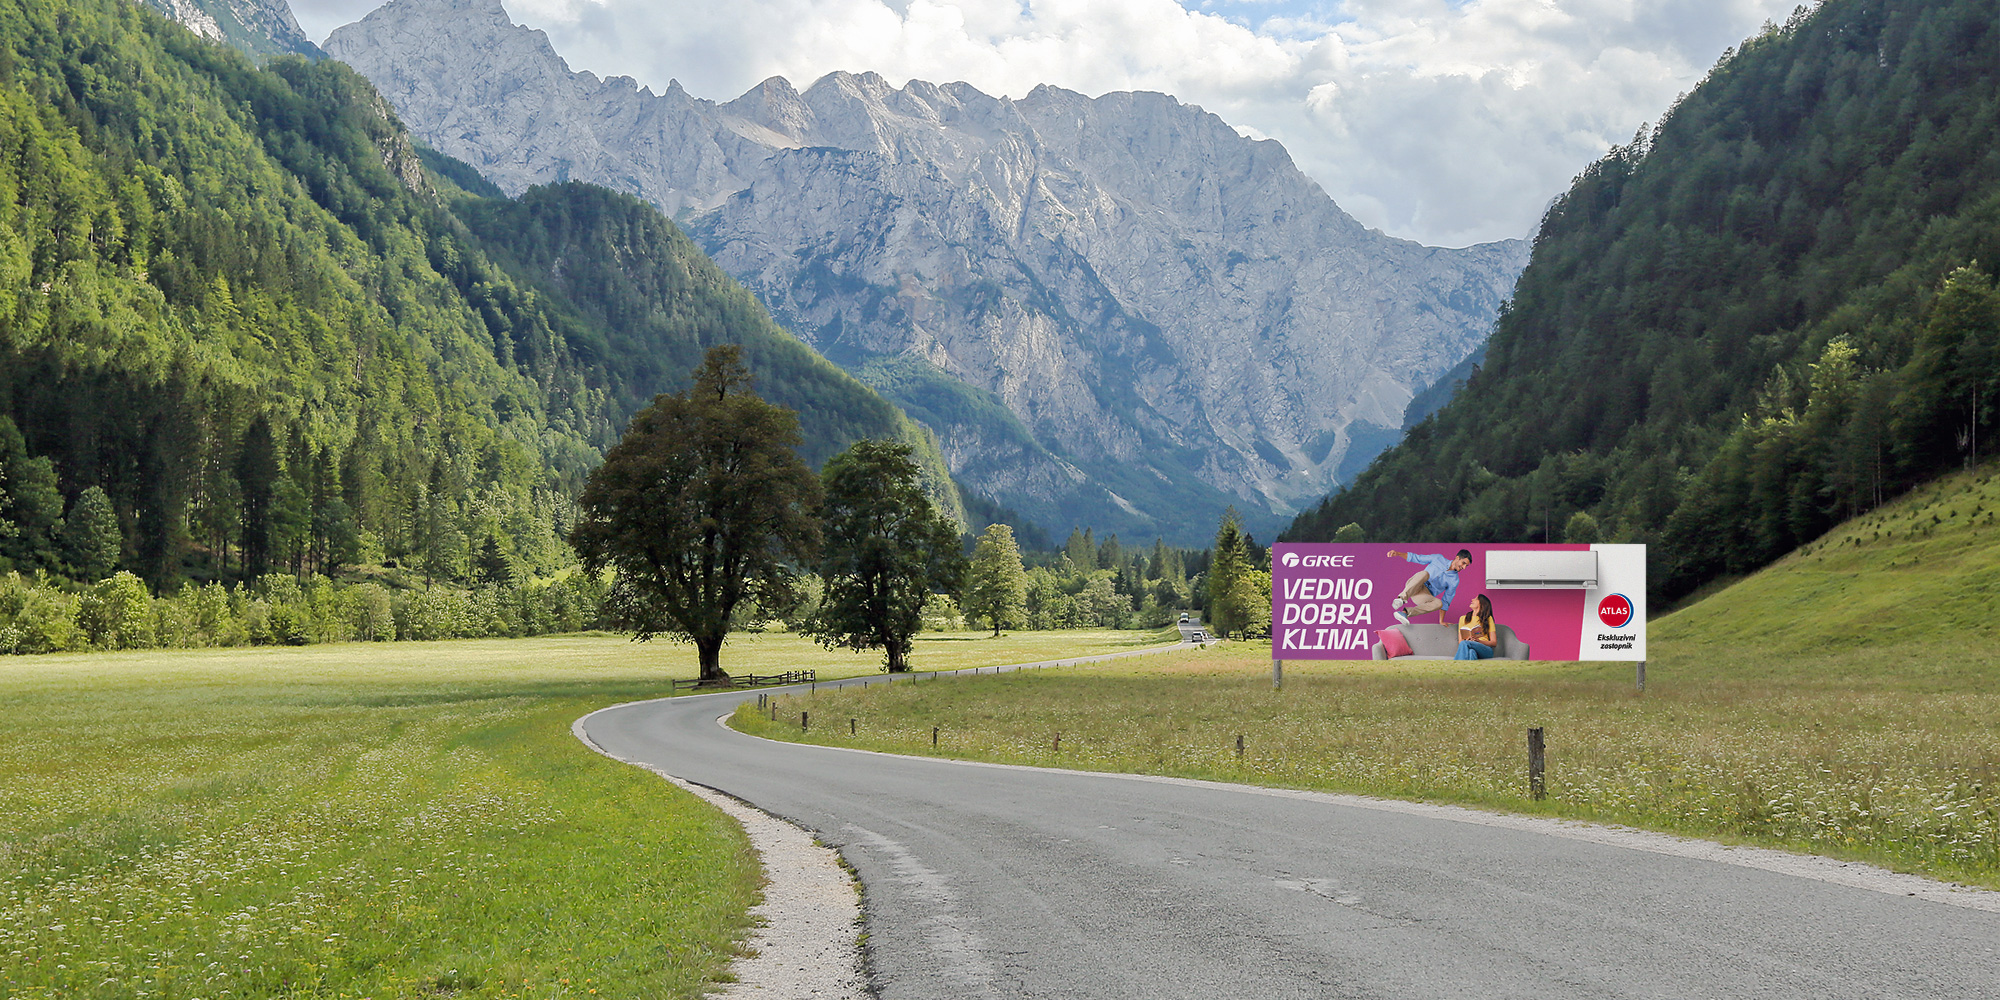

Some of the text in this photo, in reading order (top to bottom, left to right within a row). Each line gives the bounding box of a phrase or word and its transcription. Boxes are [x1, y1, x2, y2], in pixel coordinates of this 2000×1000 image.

[1302, 556, 1355, 567] GREE
[1283, 578, 1373, 600] VEDNO
[1281, 603, 1372, 625] DOBRA
[1600, 607, 1628, 615] ATLAS
[1281, 628, 1369, 650] KLIMA
[1600, 643, 1633, 651] zastopnik
